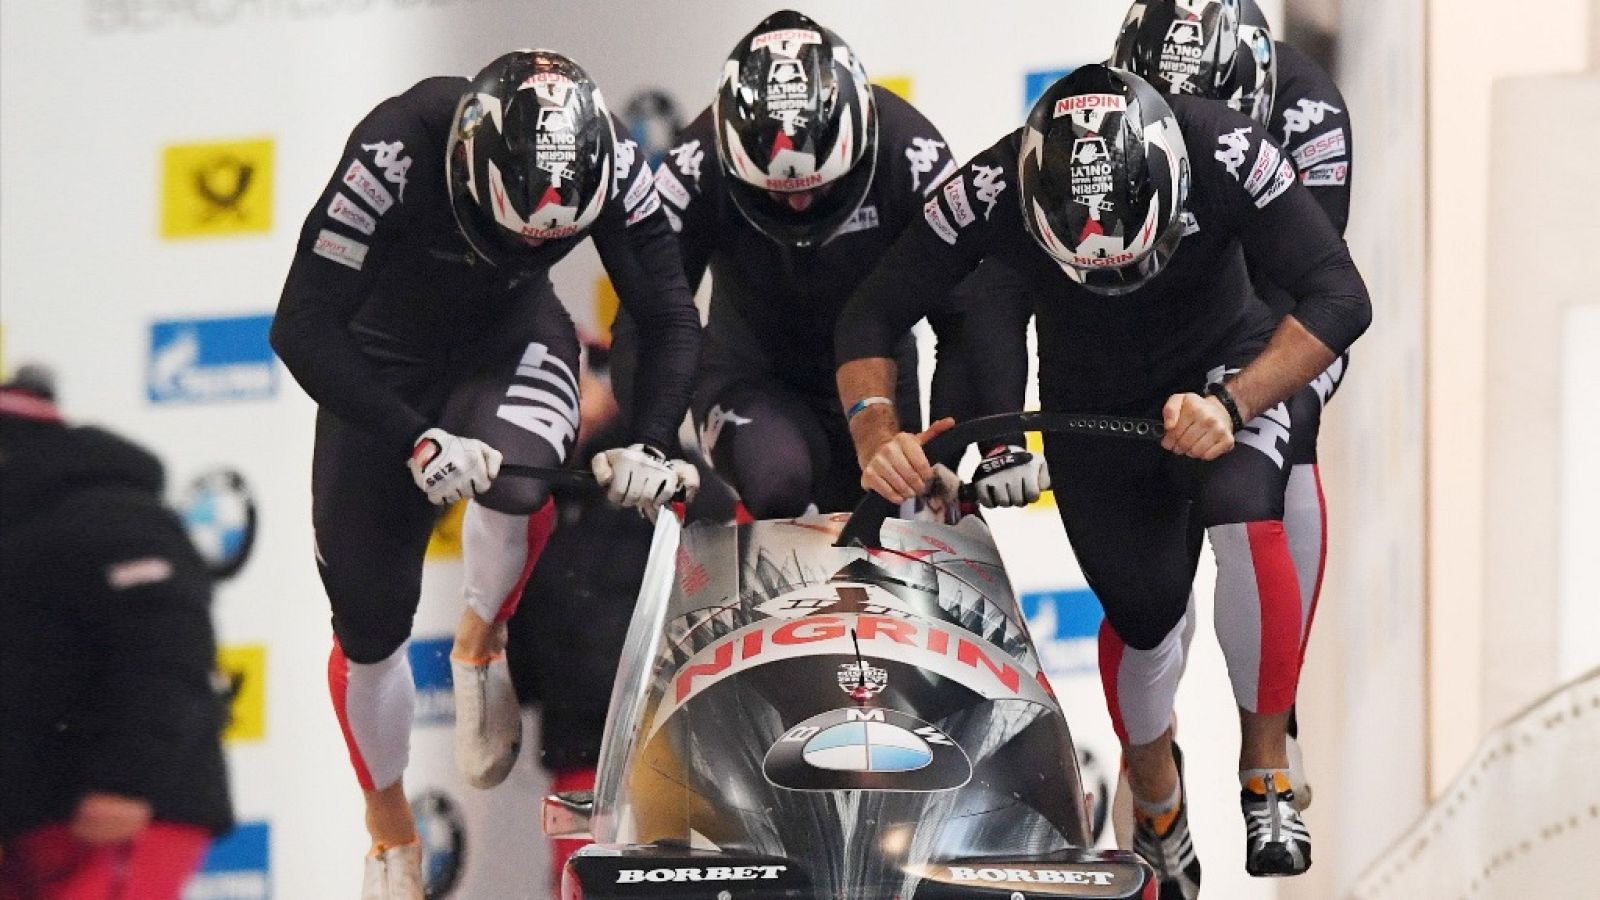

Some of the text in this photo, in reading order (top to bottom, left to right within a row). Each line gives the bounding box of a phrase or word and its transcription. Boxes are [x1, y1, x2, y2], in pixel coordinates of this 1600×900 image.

[1057, 96, 1120, 113] NIGRIN
[766, 173, 823, 189] NIGRIN
[1071, 182, 1114, 196] NIGRIN
[521, 224, 579, 239] NIGRIN
[1073, 252, 1134, 267] NIGRIN
[497, 342, 580, 464] AUT
[426, 462, 457, 487] SEIZ
[675, 614, 1021, 705] NIGRIN
[781, 707, 954, 747] BMW
[616, 865, 787, 884] BORBET
[948, 866, 1115, 886] BORBET
